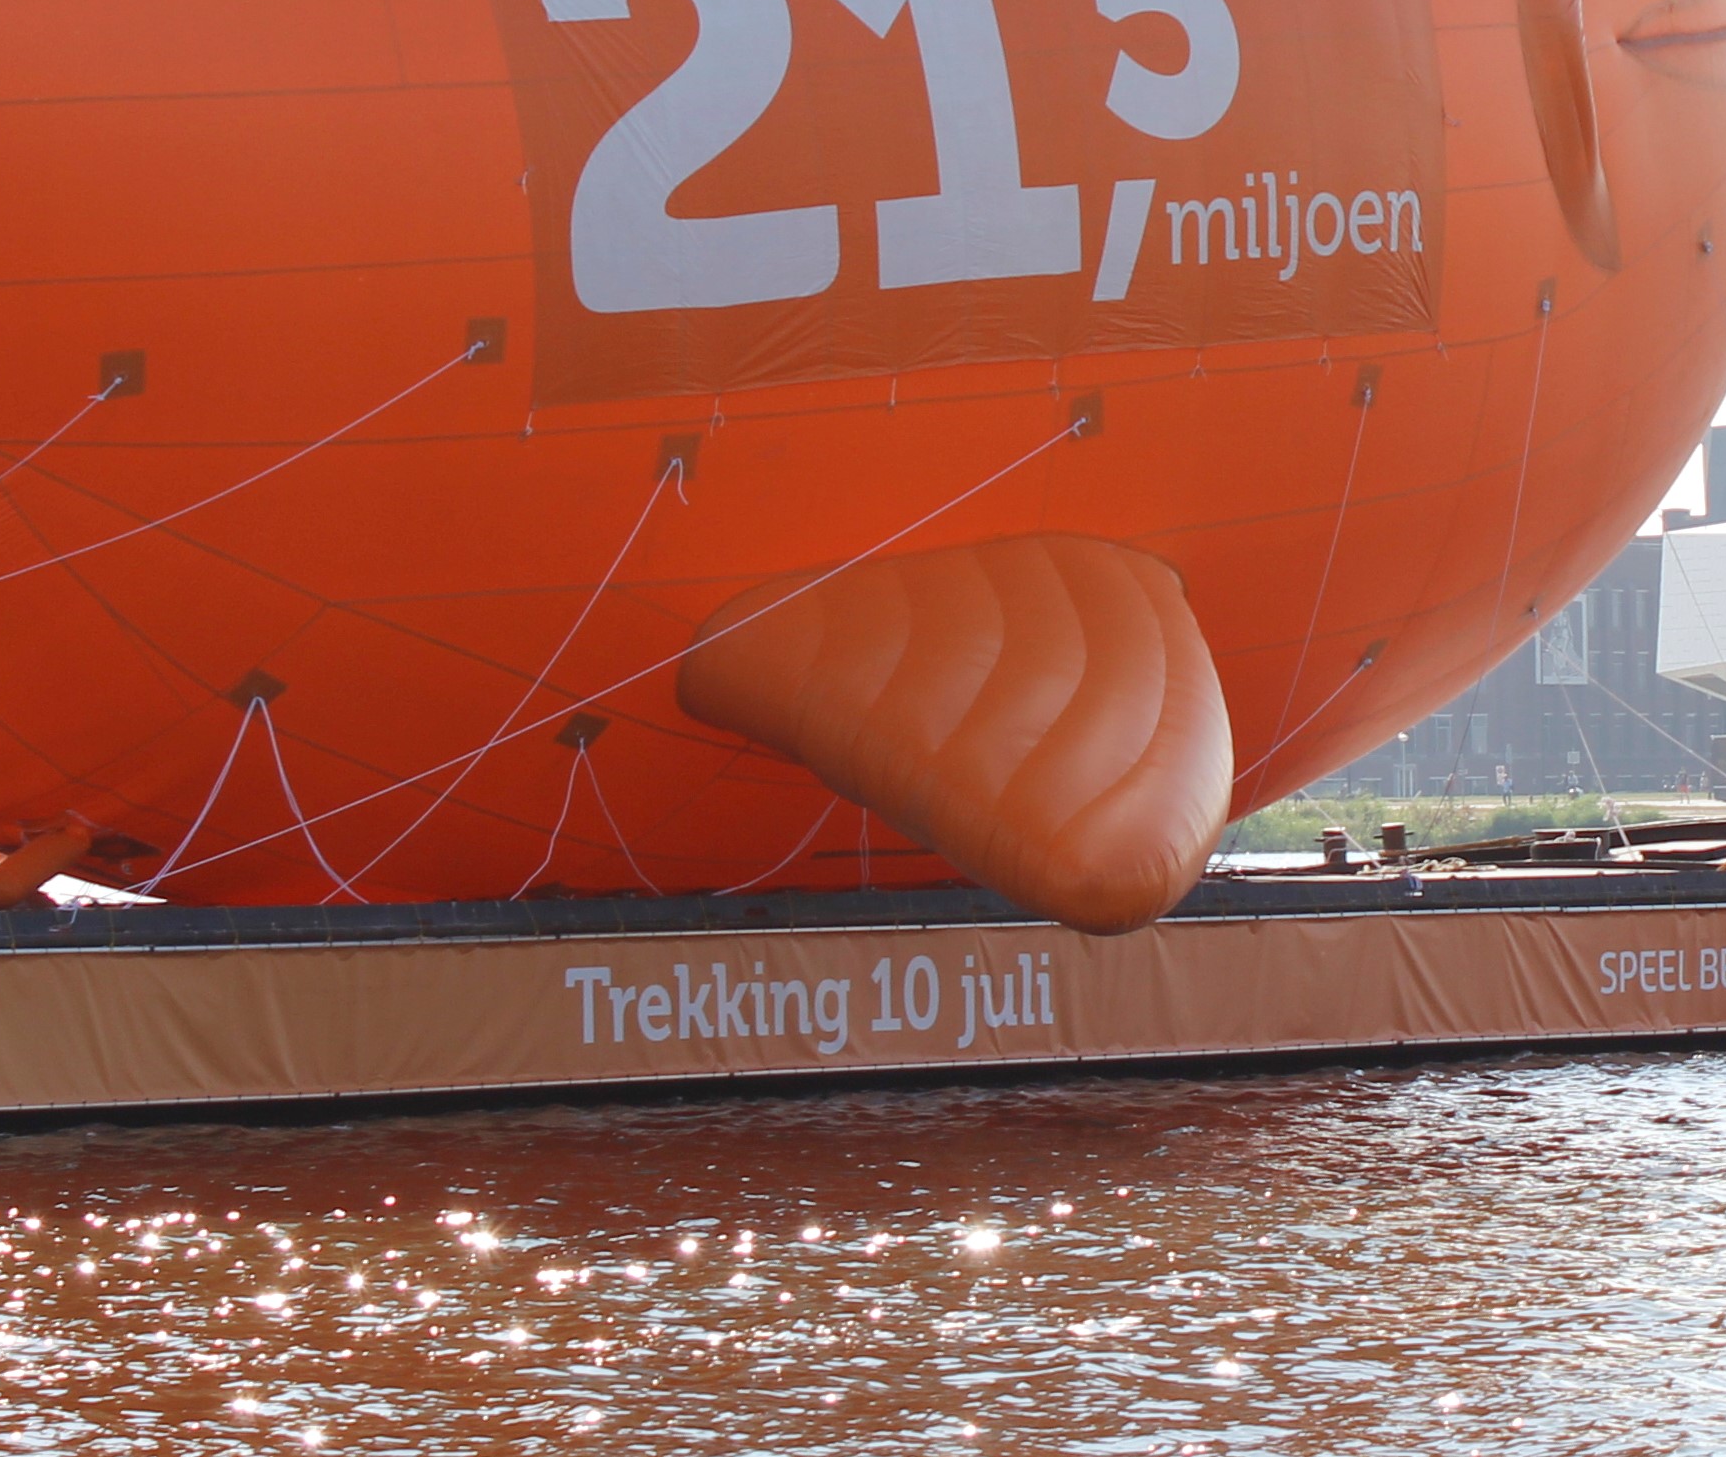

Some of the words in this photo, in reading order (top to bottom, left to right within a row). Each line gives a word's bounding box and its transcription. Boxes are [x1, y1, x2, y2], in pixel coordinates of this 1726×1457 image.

[1165, 171, 1423, 282] miljoen
[565, 960, 850, 1055] Trekking
[871, 955, 940, 1032] 10
[958, 952, 1055, 1049] juli
[1599, 950, 1692, 994] SPEEL
